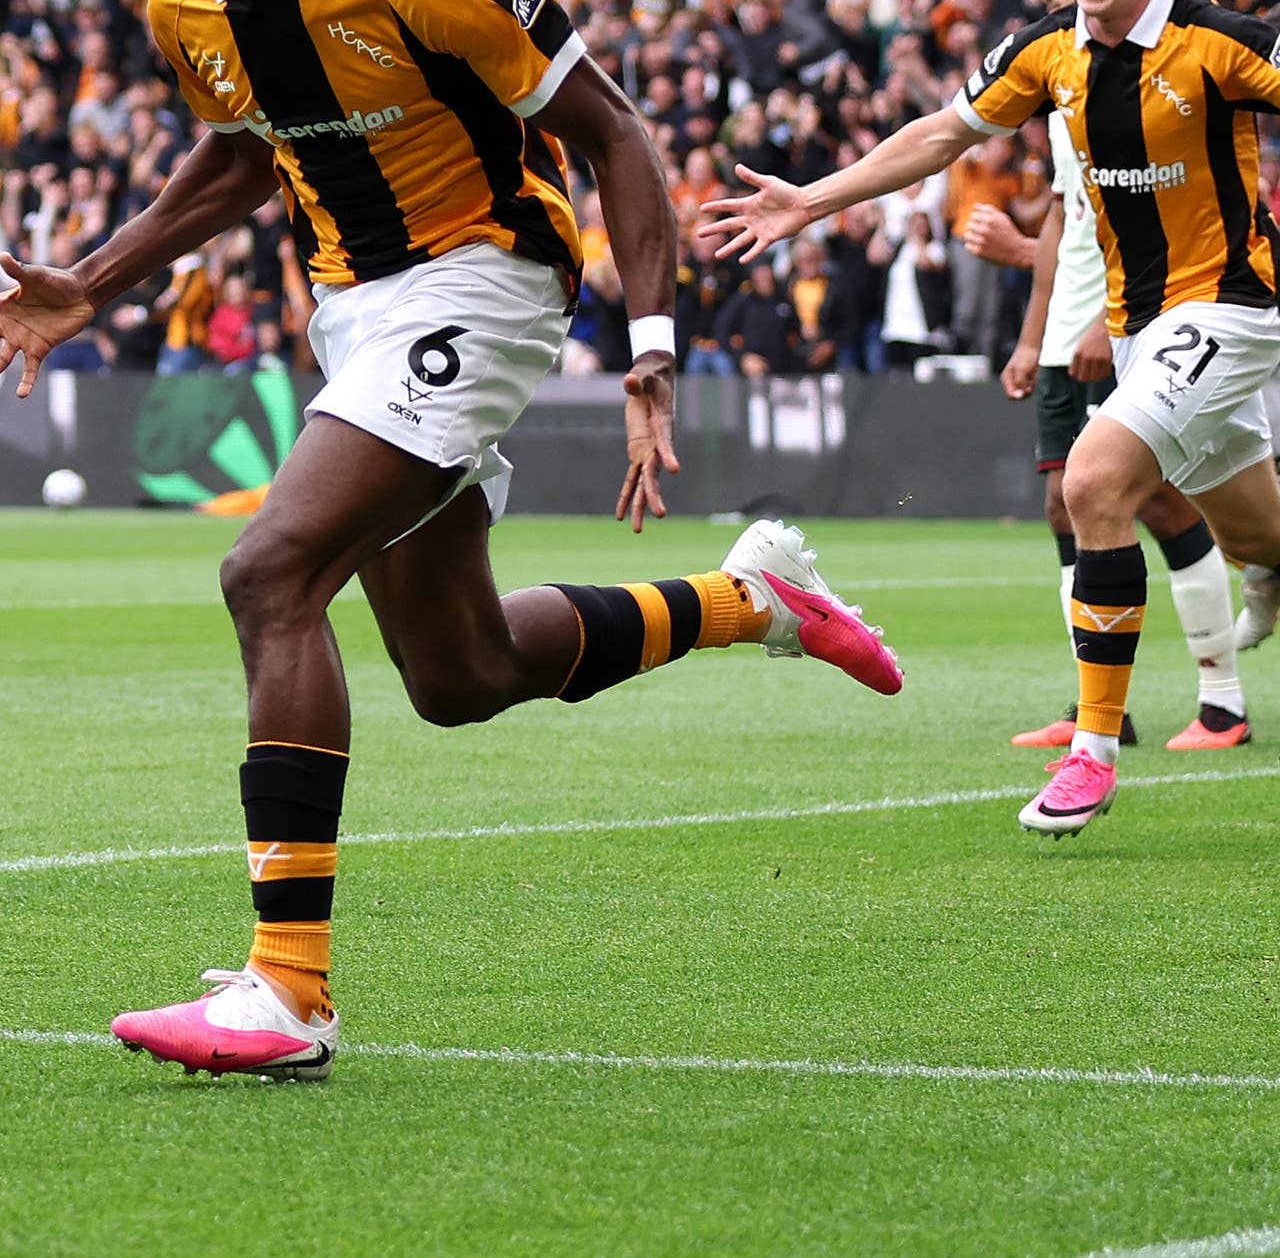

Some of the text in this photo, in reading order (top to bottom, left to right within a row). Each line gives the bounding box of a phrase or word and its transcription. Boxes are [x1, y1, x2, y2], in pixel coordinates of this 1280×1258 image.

[275, 105, 403, 138] corendon
[1089, 161, 1185, 187] corendon
[1130, 175, 1186, 194] AIRLINES
[408, 324, 472, 388] 6
[1152, 324, 1220, 386] 21
[387, 401, 422, 425] OXEN
